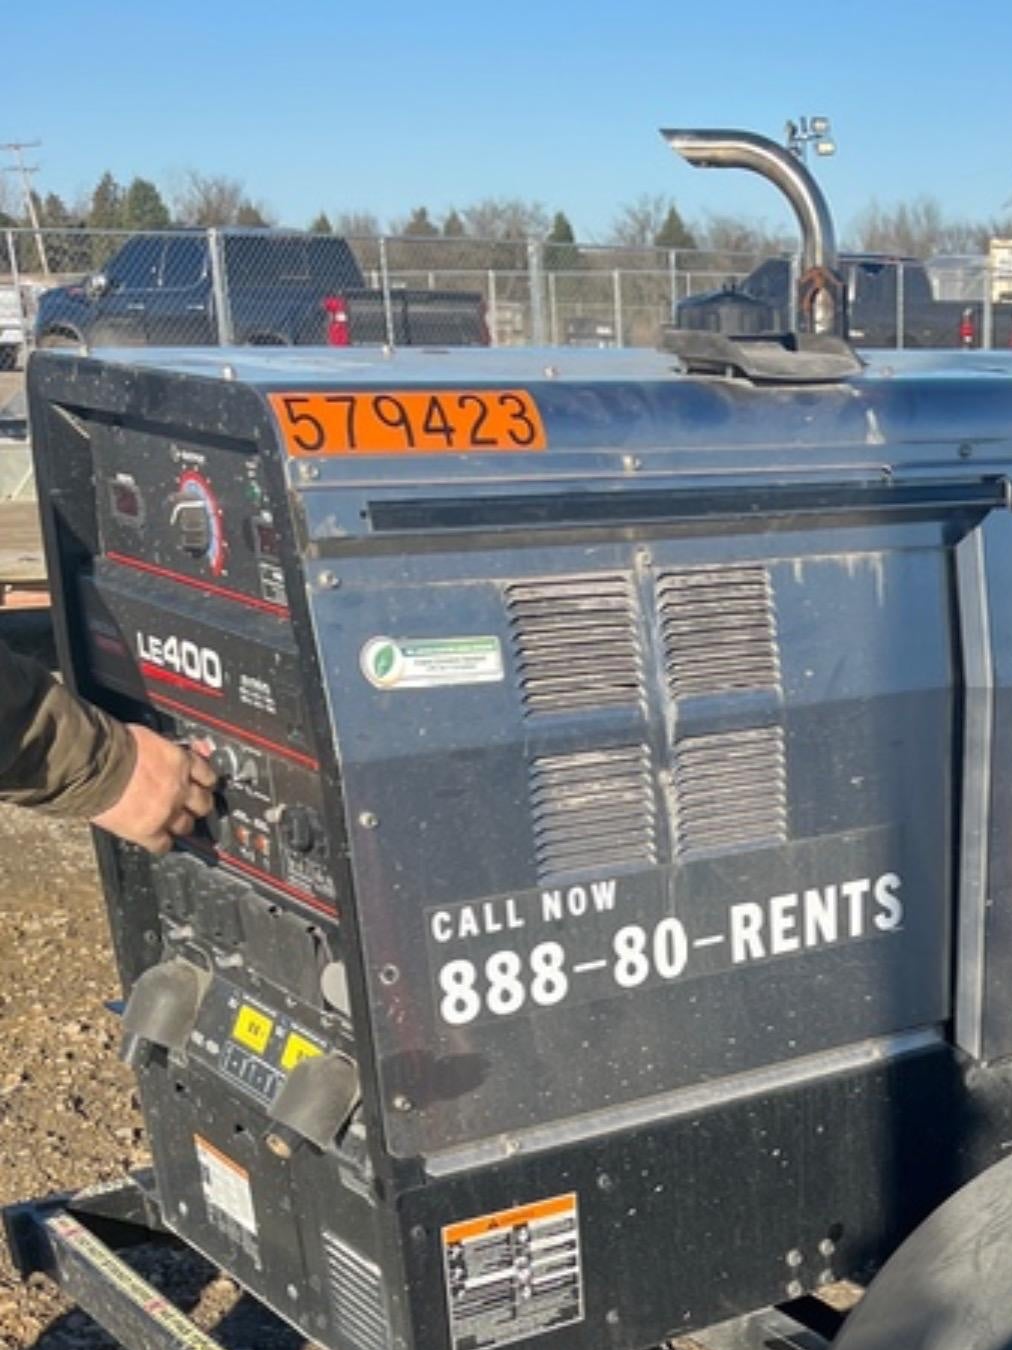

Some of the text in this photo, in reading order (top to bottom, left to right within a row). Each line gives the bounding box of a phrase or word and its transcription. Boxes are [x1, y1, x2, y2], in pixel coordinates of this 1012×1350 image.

[284, 392, 537, 453] 579423
[136, 631, 222, 689] LE400
[431, 879, 618, 943] CALL NOW
[439, 872, 903, 1025] 888-80-RENTS
